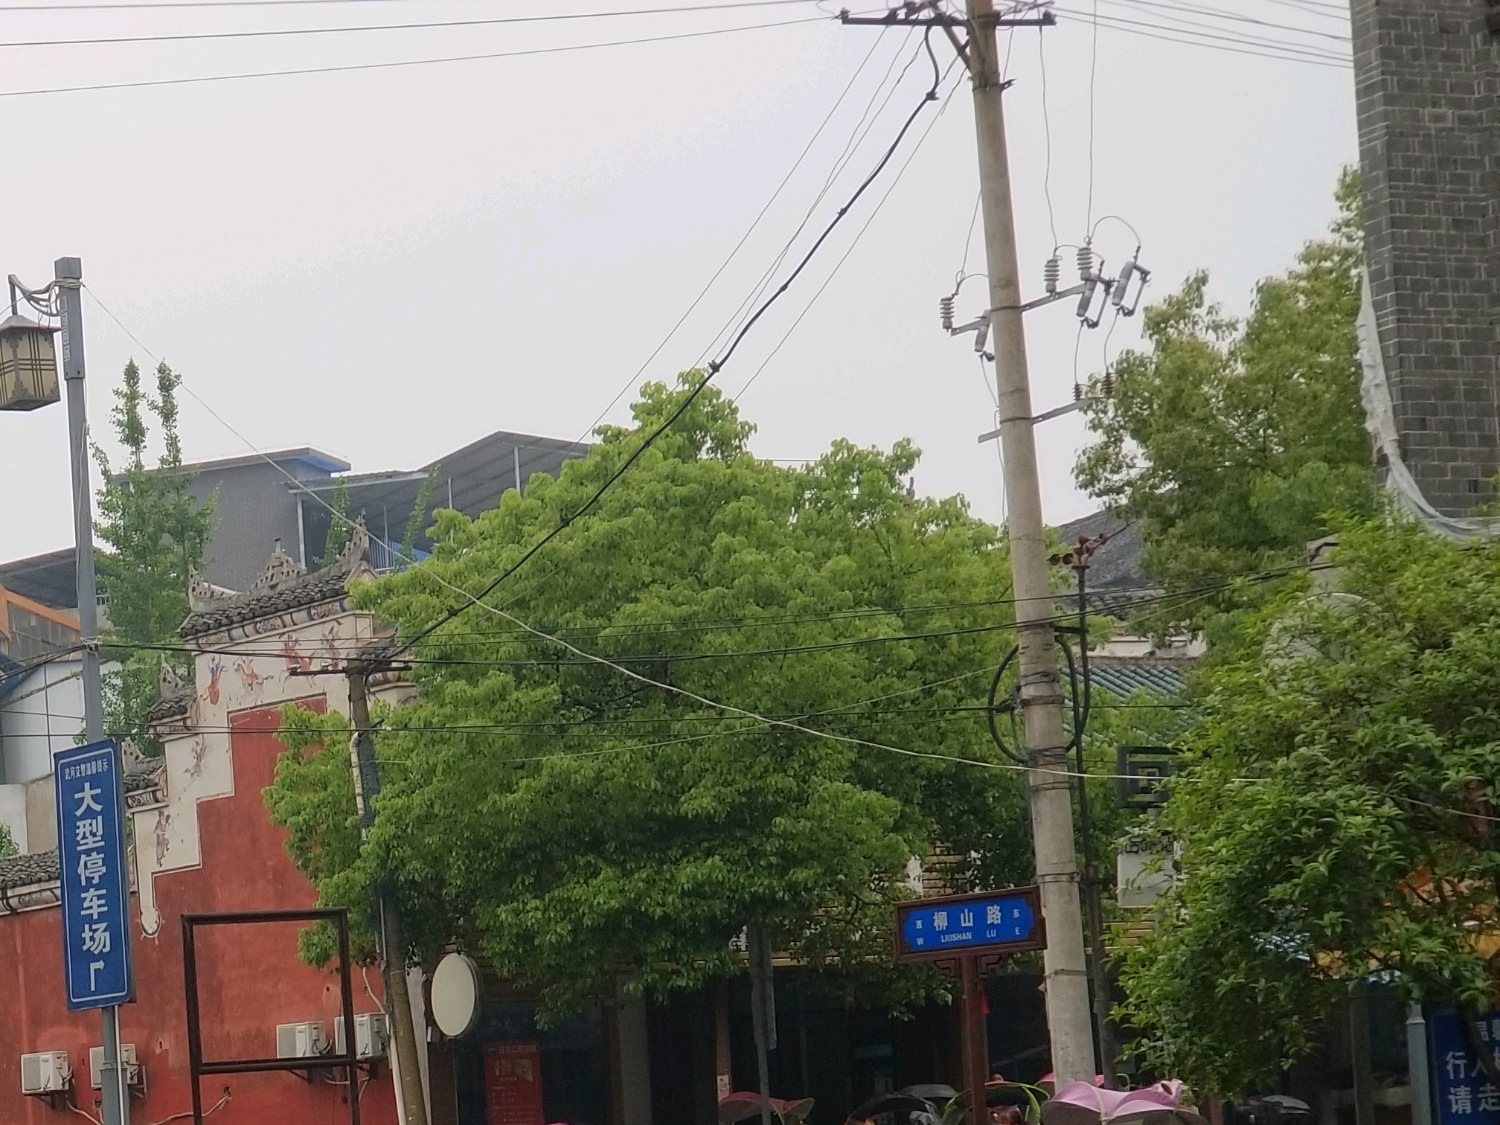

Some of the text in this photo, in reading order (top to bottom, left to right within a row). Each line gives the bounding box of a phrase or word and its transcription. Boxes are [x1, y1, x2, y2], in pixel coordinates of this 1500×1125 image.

[74, 781, 111, 955] 大型停车场
[933, 904, 1002, 931] 柳山路
[917, 927, 1020, 946] W LIUSHAN LU E
